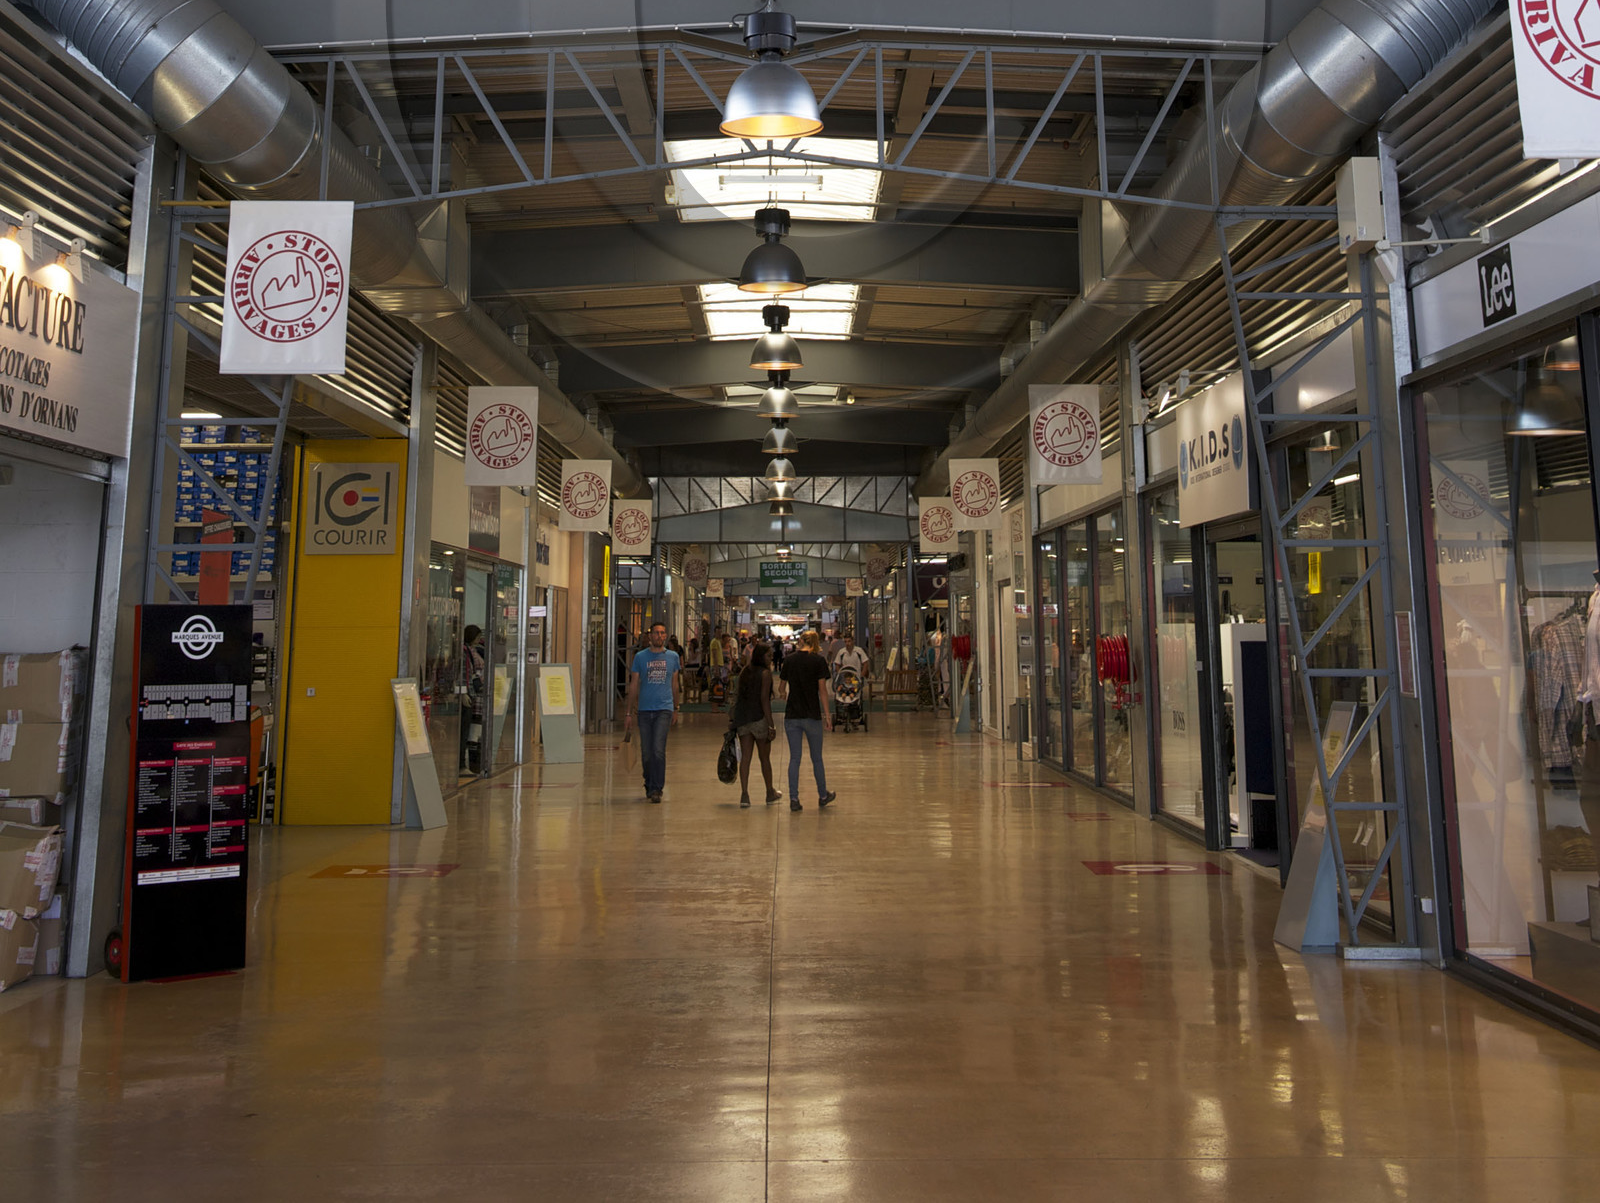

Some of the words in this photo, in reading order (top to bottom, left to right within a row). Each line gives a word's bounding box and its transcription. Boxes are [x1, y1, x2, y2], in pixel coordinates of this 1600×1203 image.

[284, 234, 340, 297] STOCK
[234, 248, 317, 339] ARRIVAGES
[1480, 262, 1514, 318] Lee
[19, 390, 79, 434] D'ORNANS
[498, 405, 532, 443] STOCK
[1060, 403, 1095, 441] STOCK
[471, 414, 519, 467] ARRIVAGES
[1035, 412, 1084, 465] ARRIVAGES
[1188, 422, 1230, 472] K.I.D.S
[563, 479, 597, 517] ARRIVAGES
[583, 473, 607, 500] STOCK
[953, 479, 989, 516] ARRIVAGES
[971, 472, 997, 498] STOCK
[313, 529, 387, 546] COURIR
[762, 562, 793, 570] SORTIE
[764, 569, 804, 577] SECOURS
[174, 633, 199, 641] MARQUES
